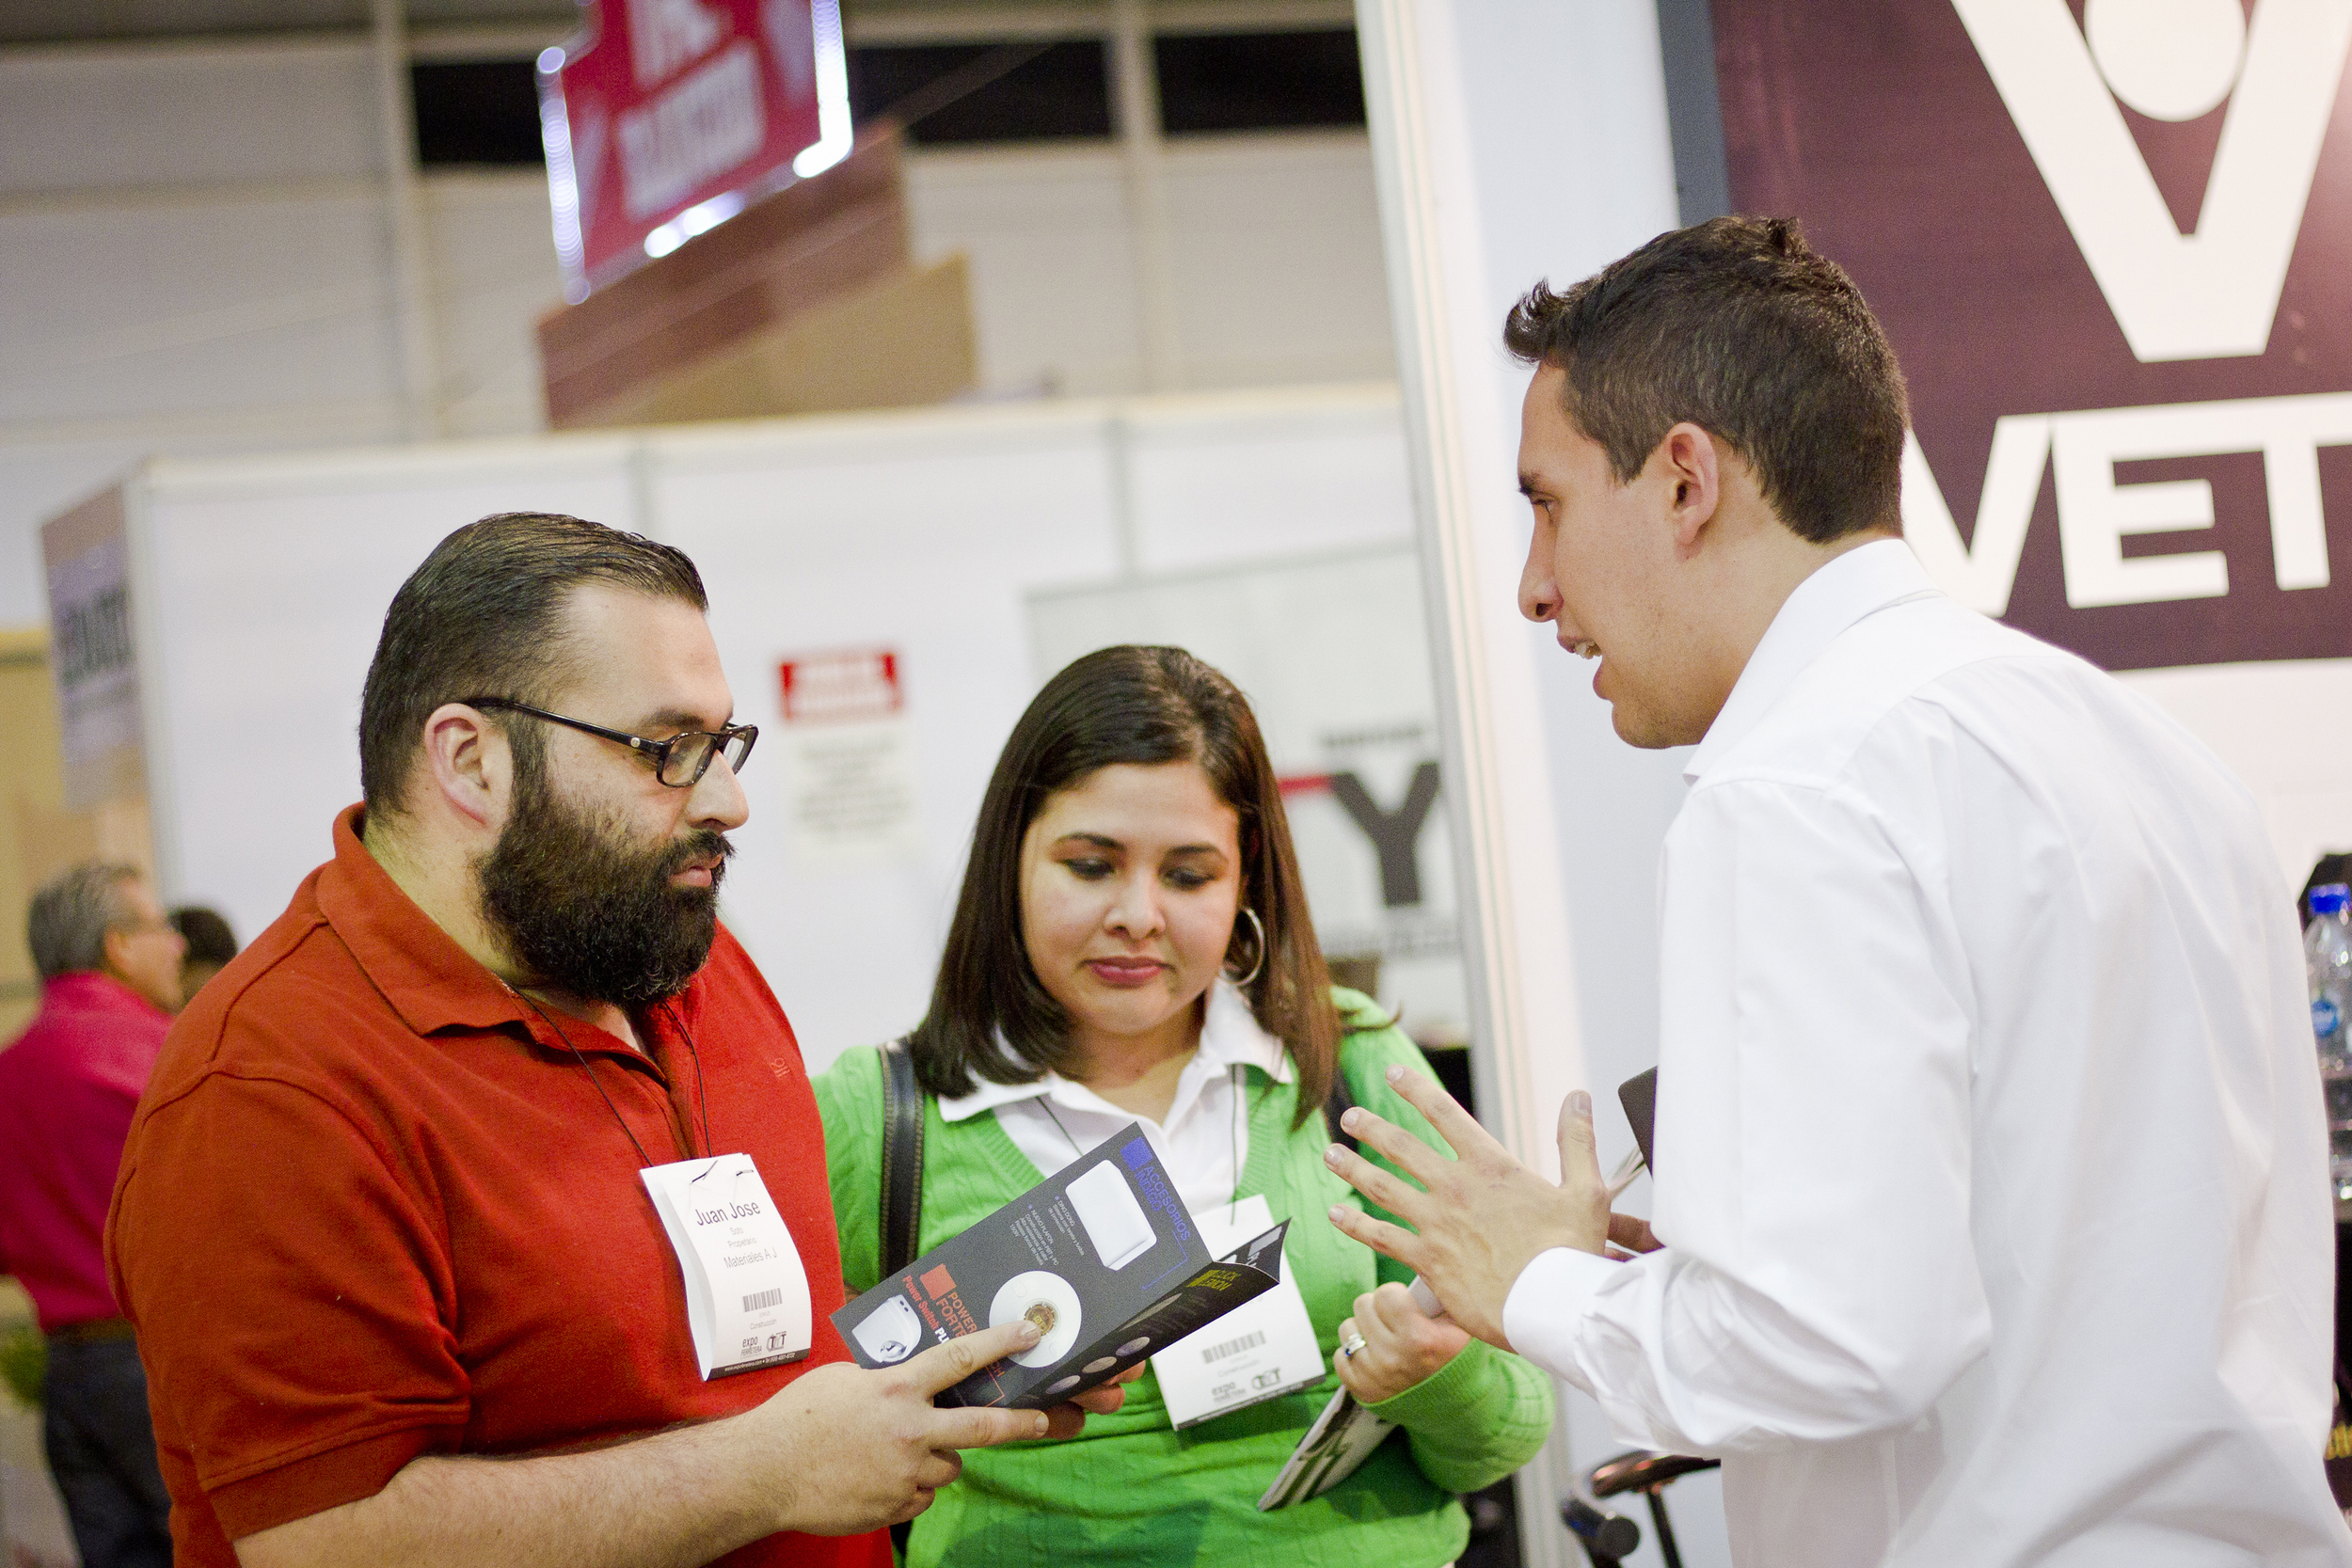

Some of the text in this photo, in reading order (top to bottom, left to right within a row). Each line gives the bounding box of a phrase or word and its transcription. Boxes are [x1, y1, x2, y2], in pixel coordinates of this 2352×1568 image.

[1135, 1169, 1163, 1212] INDIGO
[1144, 1165, 1191, 1241] ACCESORIOS
[695, 1202, 760, 1226] Juan Jose
[723, 1252, 764, 1269] Materiales
[764, 1248, 771, 1259] A
[903, 1275, 922, 1302] Power
[918, 1301, 939, 1330] Switch
[936, 1298, 967, 1338] FORTE
[948, 1291, 977, 1333] POWER
[742, 1337, 758, 1349] expo
[1212, 1382, 1236, 1396] expo
